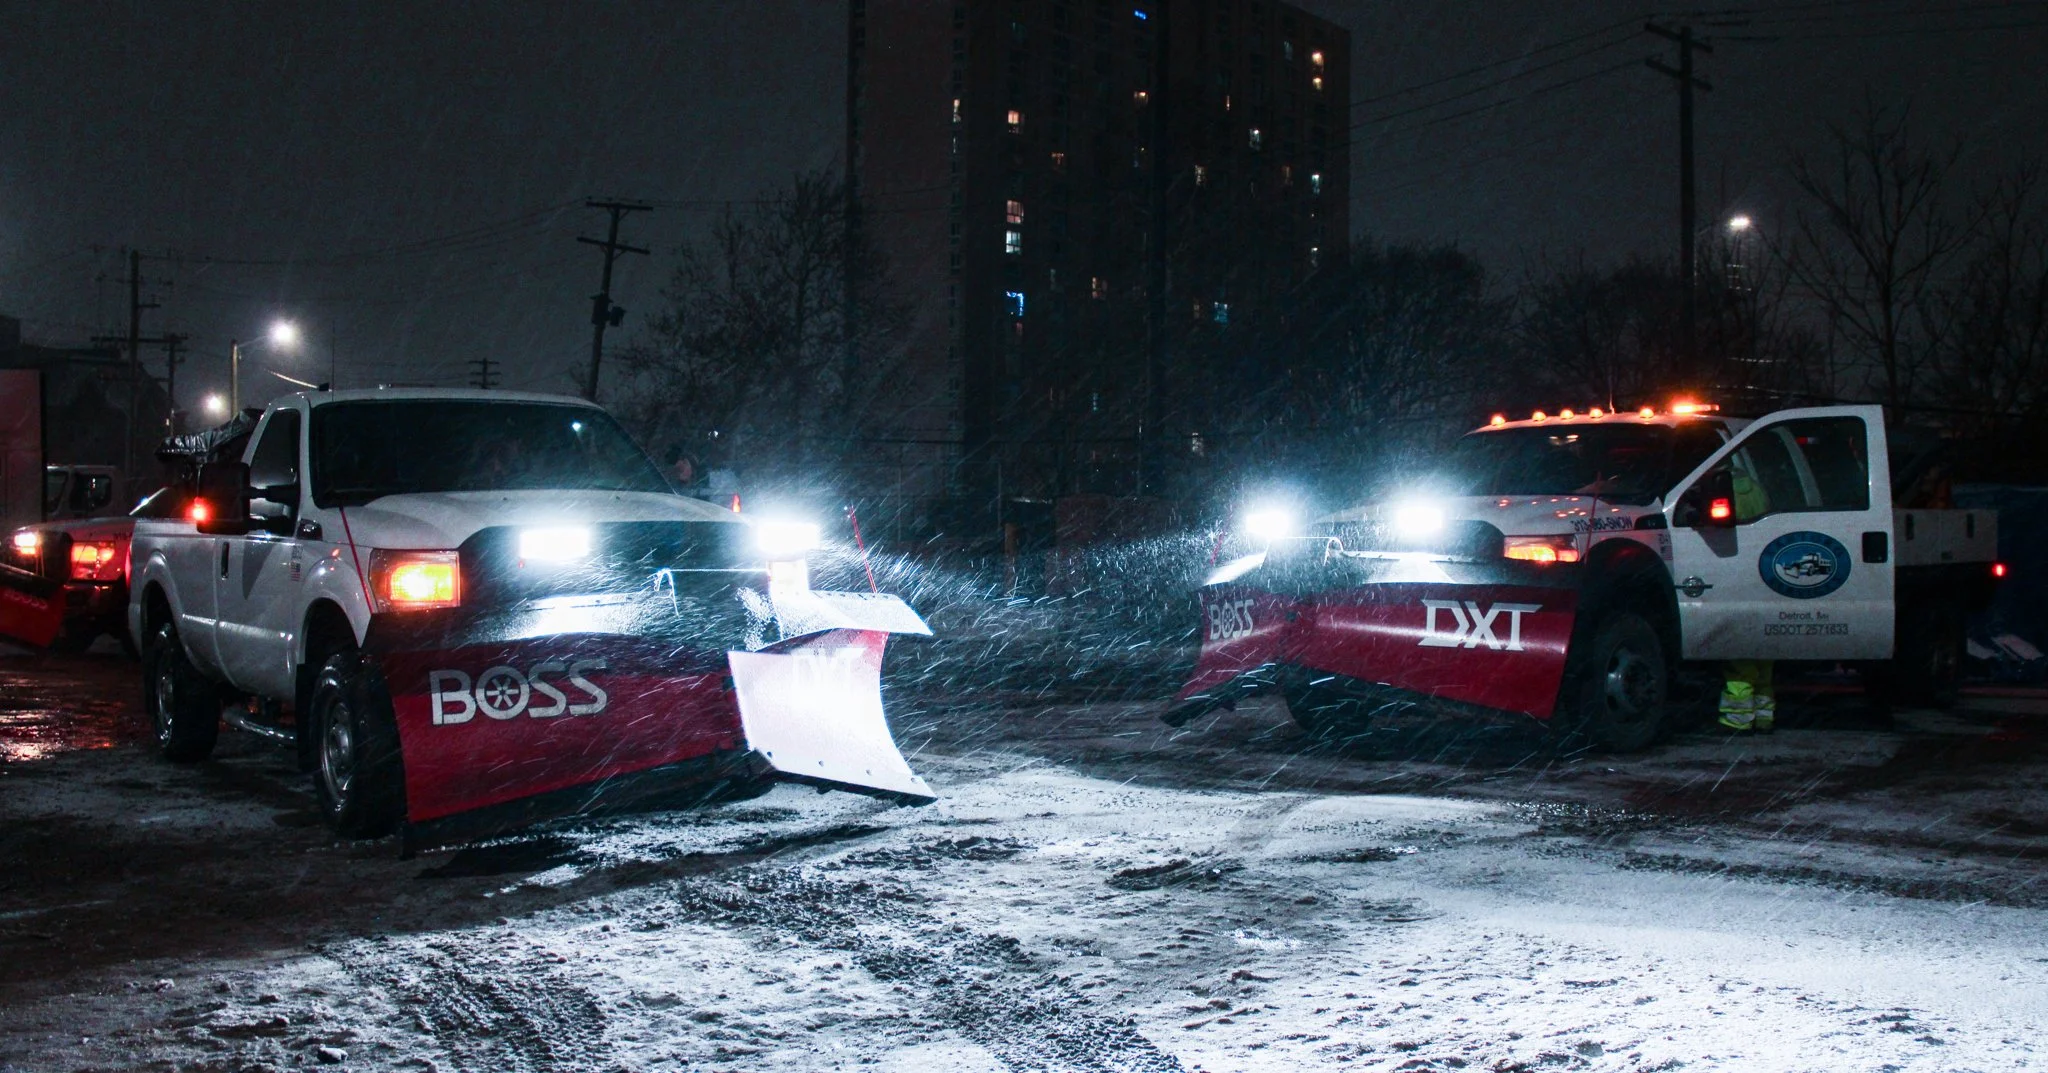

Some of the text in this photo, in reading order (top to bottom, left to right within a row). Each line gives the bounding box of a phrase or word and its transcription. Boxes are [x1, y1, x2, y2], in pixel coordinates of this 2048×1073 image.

[1209, 599, 1254, 640] BOSS
[1418, 599, 1543, 651] DXT
[1764, 624, 1802, 636] USDOT
[429, 658, 607, 725] BOSS
